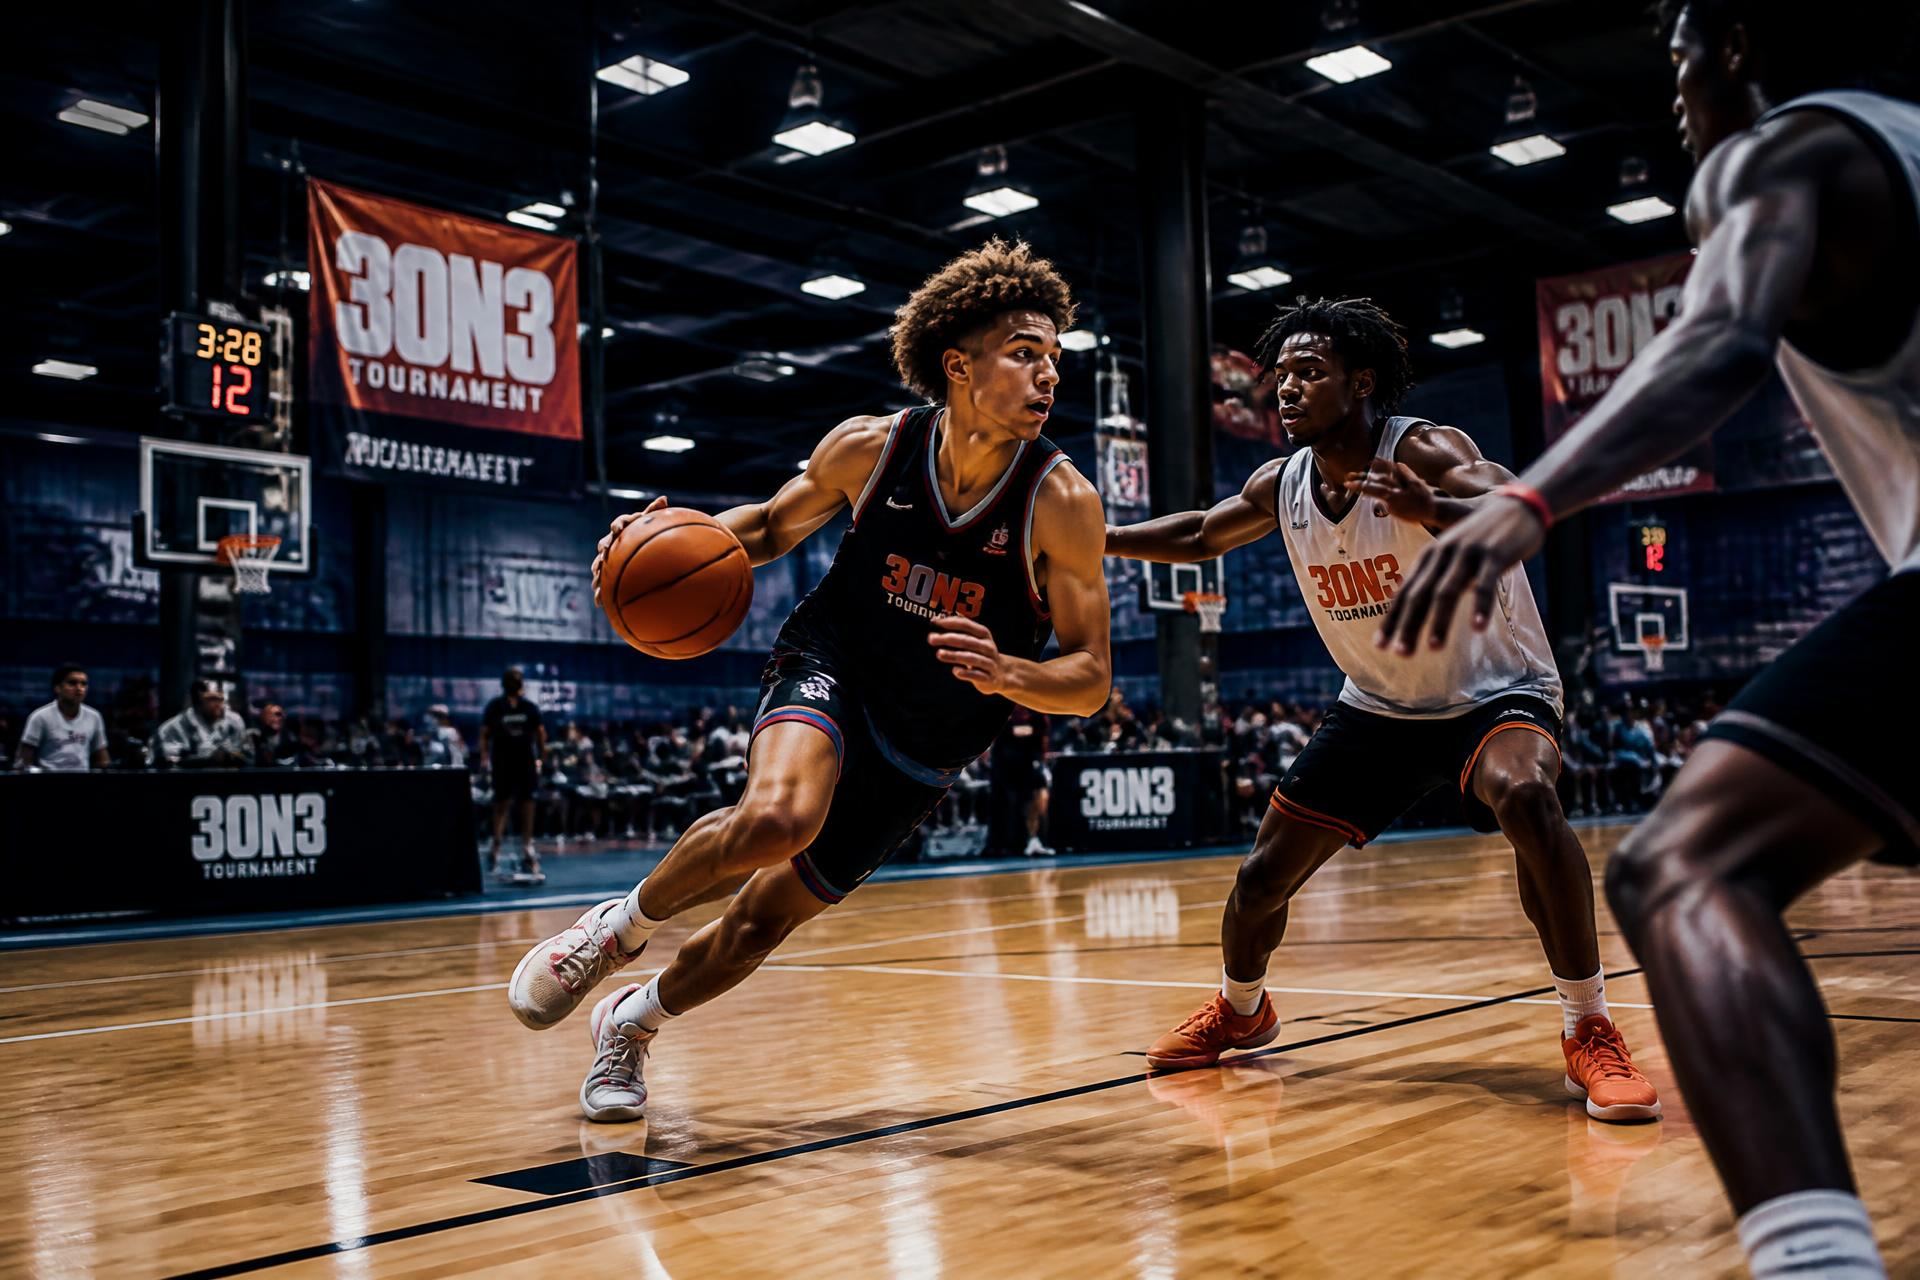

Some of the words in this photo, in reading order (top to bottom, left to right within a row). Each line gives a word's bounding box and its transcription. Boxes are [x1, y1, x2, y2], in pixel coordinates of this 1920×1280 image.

[335, 230, 556, 385] 3ON3
[196, 323, 262, 366] 3:28
[211, 363, 252, 415] 12
[348, 358, 543, 413] TOURNAMENT
[882, 553, 986, 619] 3ON3
[1080, 766, 1175, 817] 3ON3
[191, 792, 327, 861] 3ON3
[203, 857, 318, 880] TOURNAMENT
